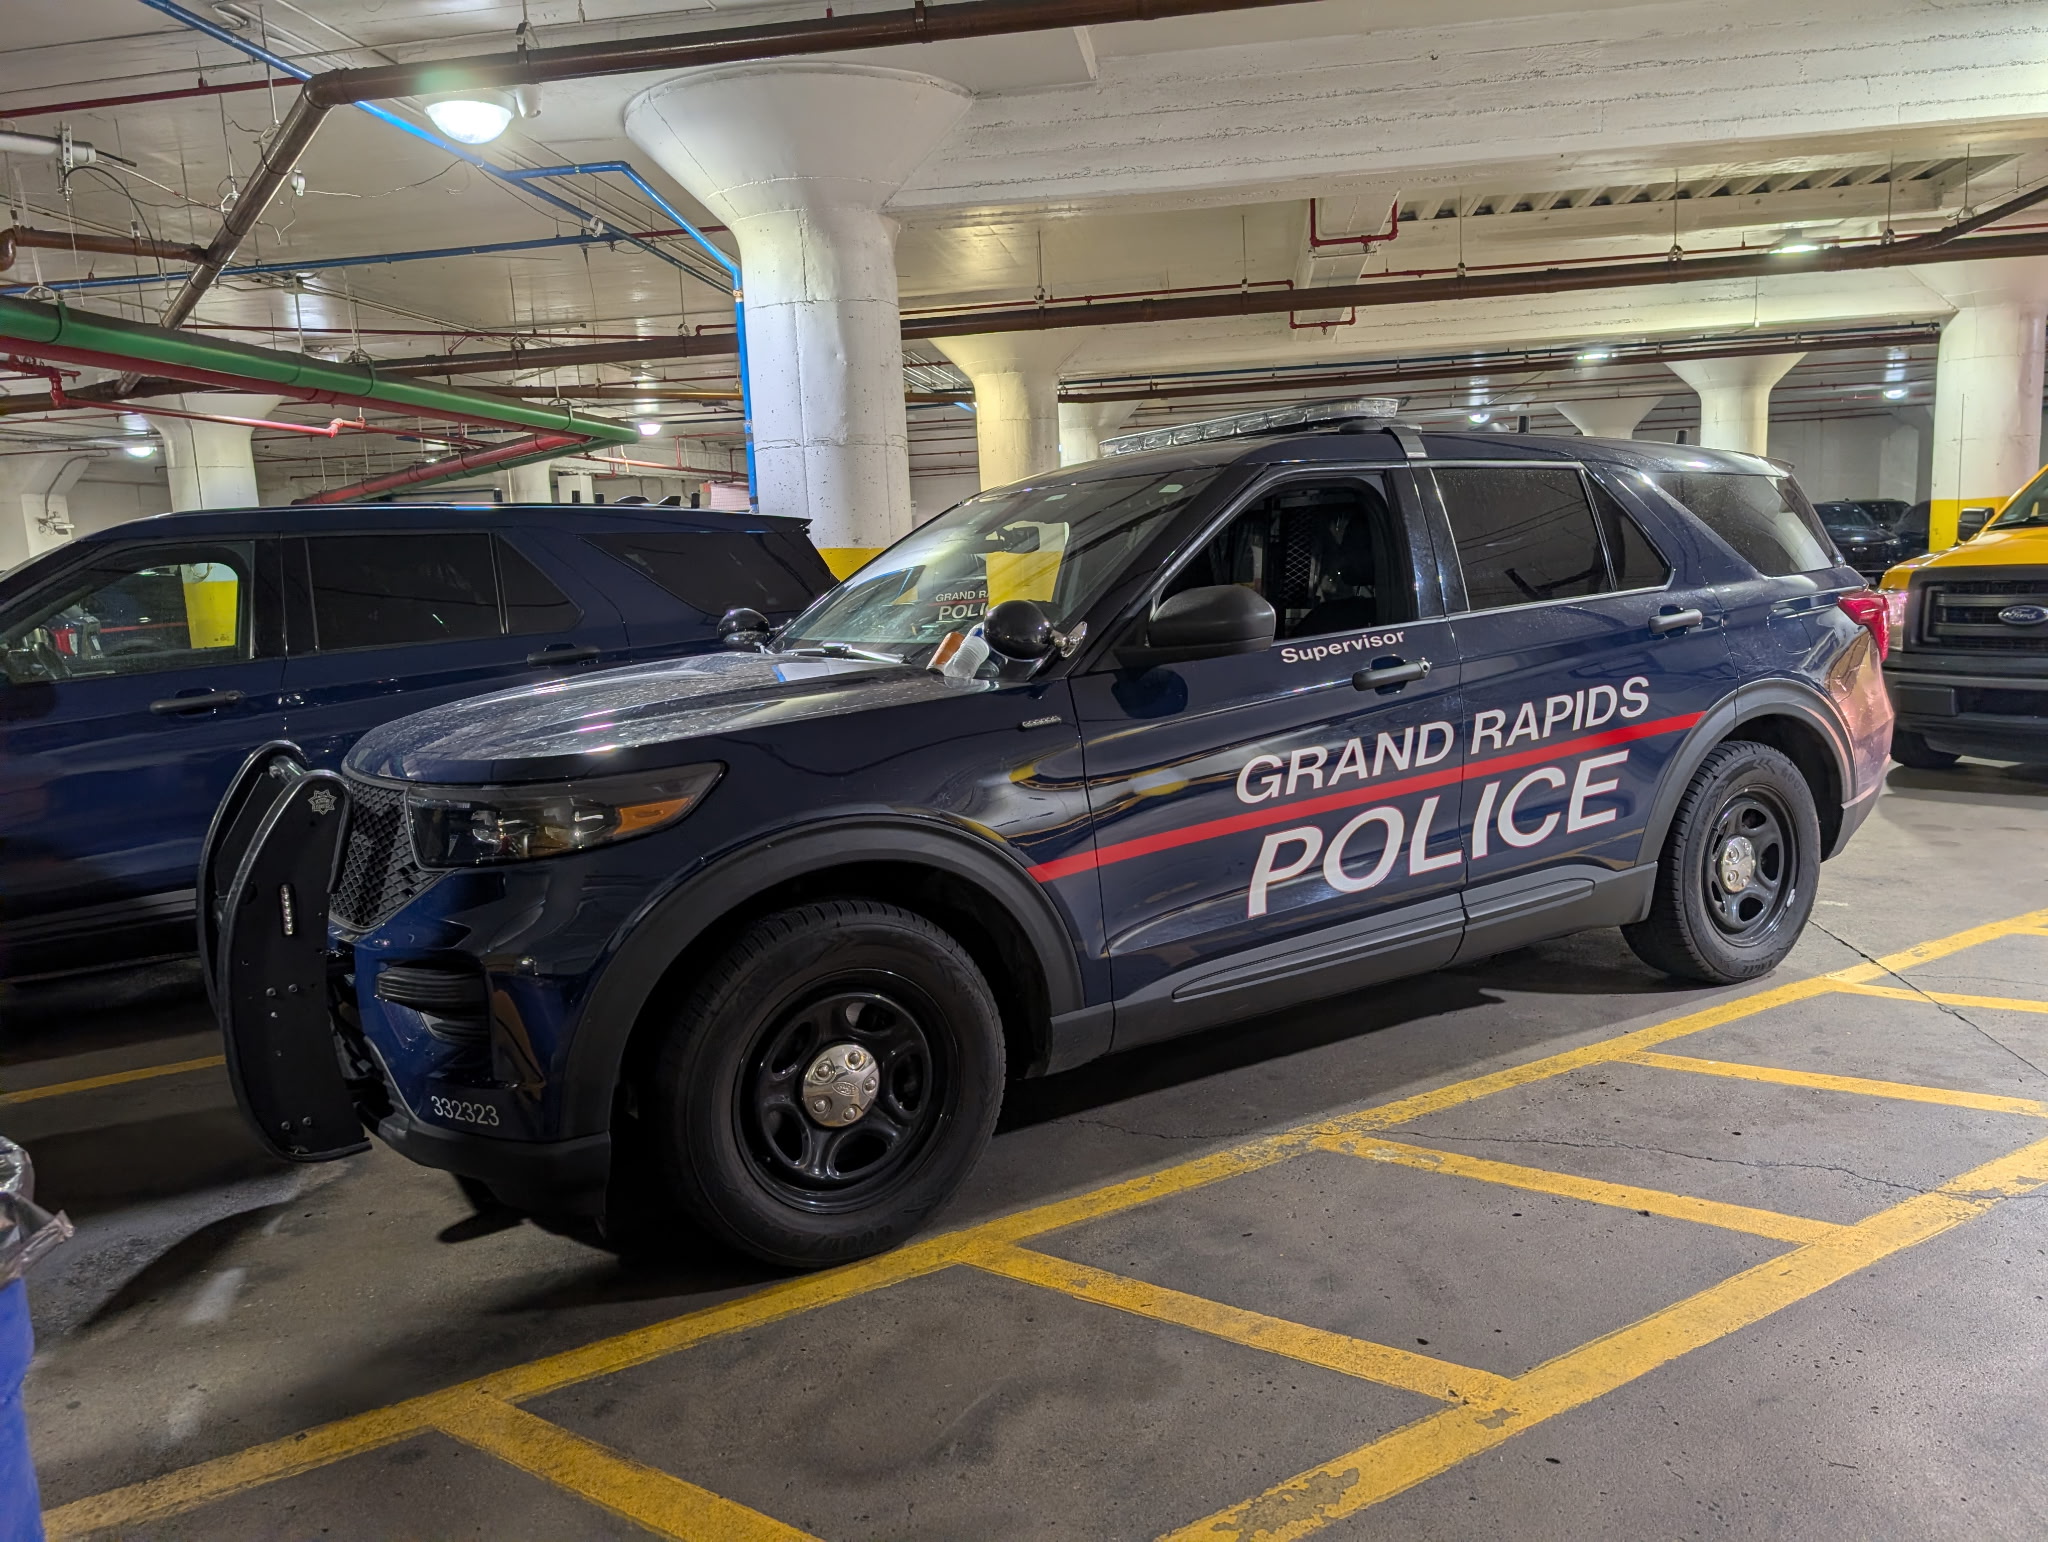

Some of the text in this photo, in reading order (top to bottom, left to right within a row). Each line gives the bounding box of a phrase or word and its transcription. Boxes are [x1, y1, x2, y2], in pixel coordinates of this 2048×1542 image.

[935, 590, 976, 602] GRAND
[2003, 608, 2038, 620] Ford
[1280, 631, 1405, 664] Supervisor
[1236, 676, 1651, 804] GRAND RAPIDS
[1247, 748, 1630, 919] POLICE
[430, 1095, 500, 1126] 332323
